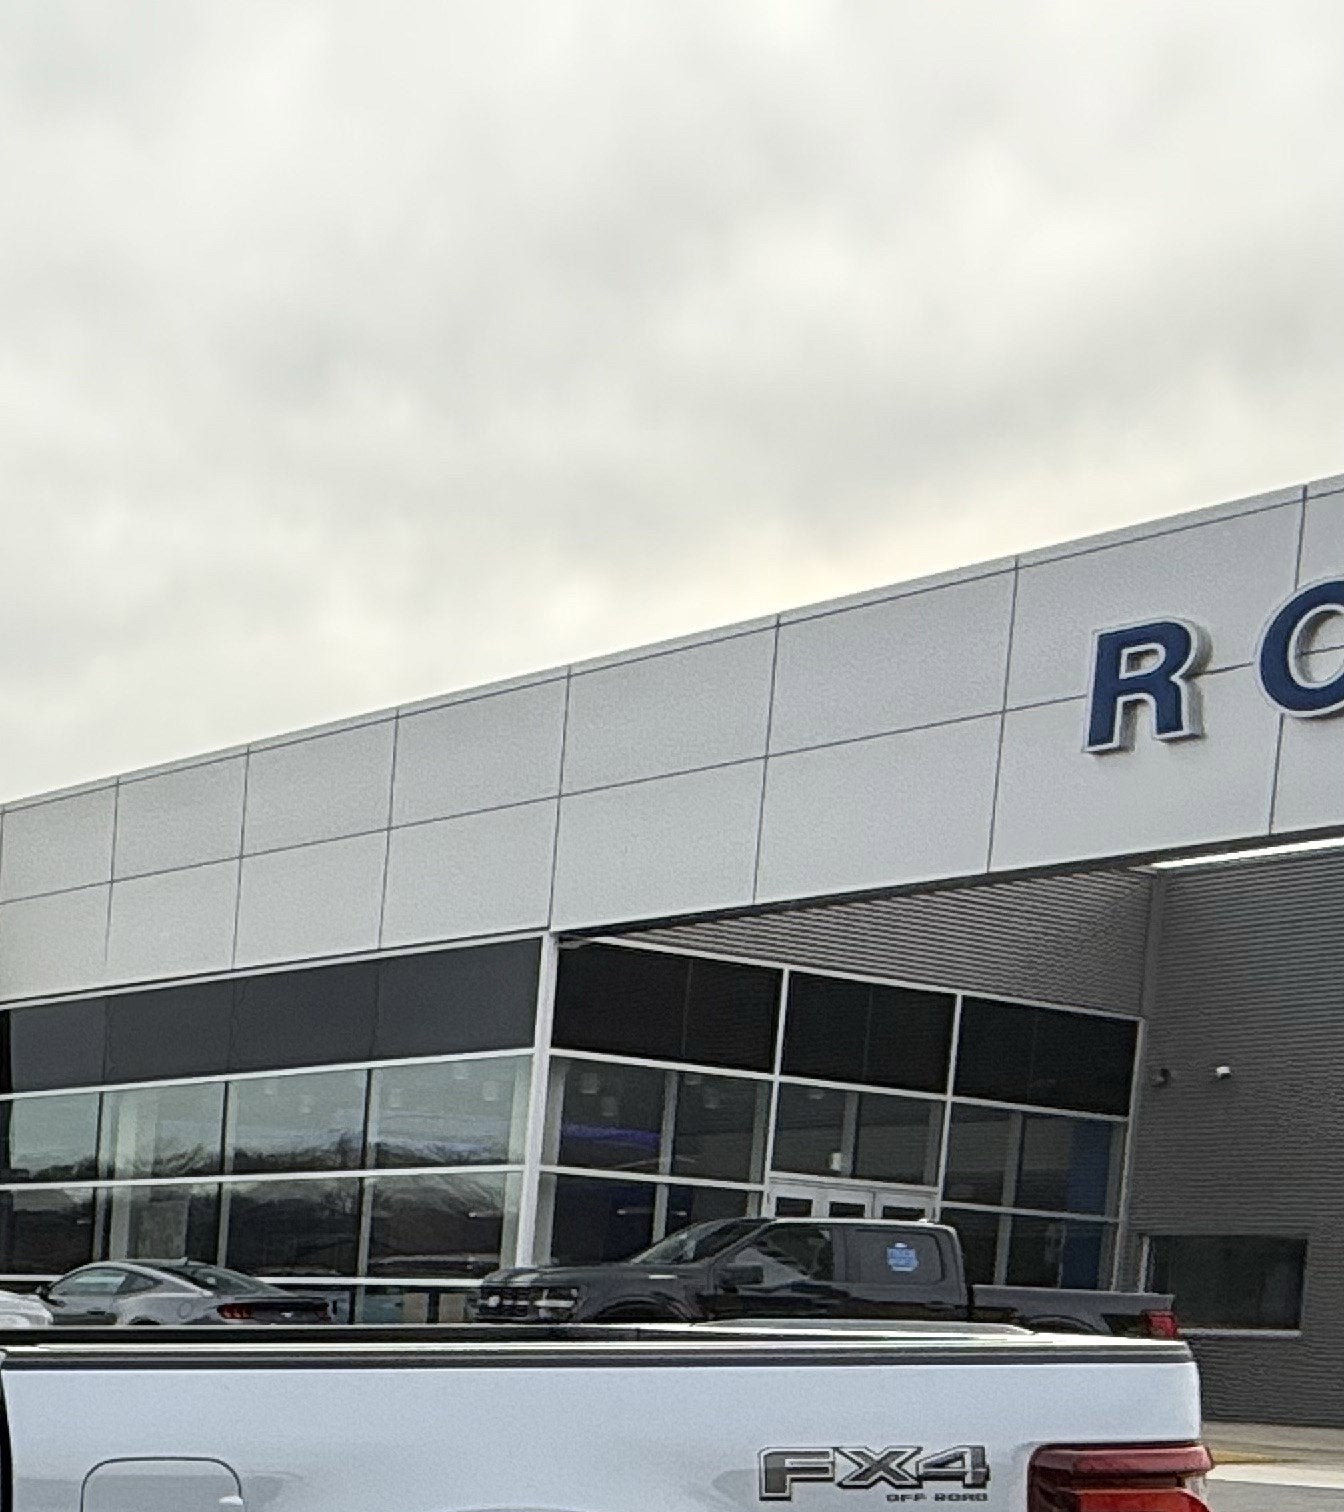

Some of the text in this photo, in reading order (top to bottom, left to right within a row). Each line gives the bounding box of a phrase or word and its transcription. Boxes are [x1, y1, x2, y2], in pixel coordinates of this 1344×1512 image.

[758, 1445, 991, 1501] FX4
[886, 1492, 989, 1502] OFF ROAD
